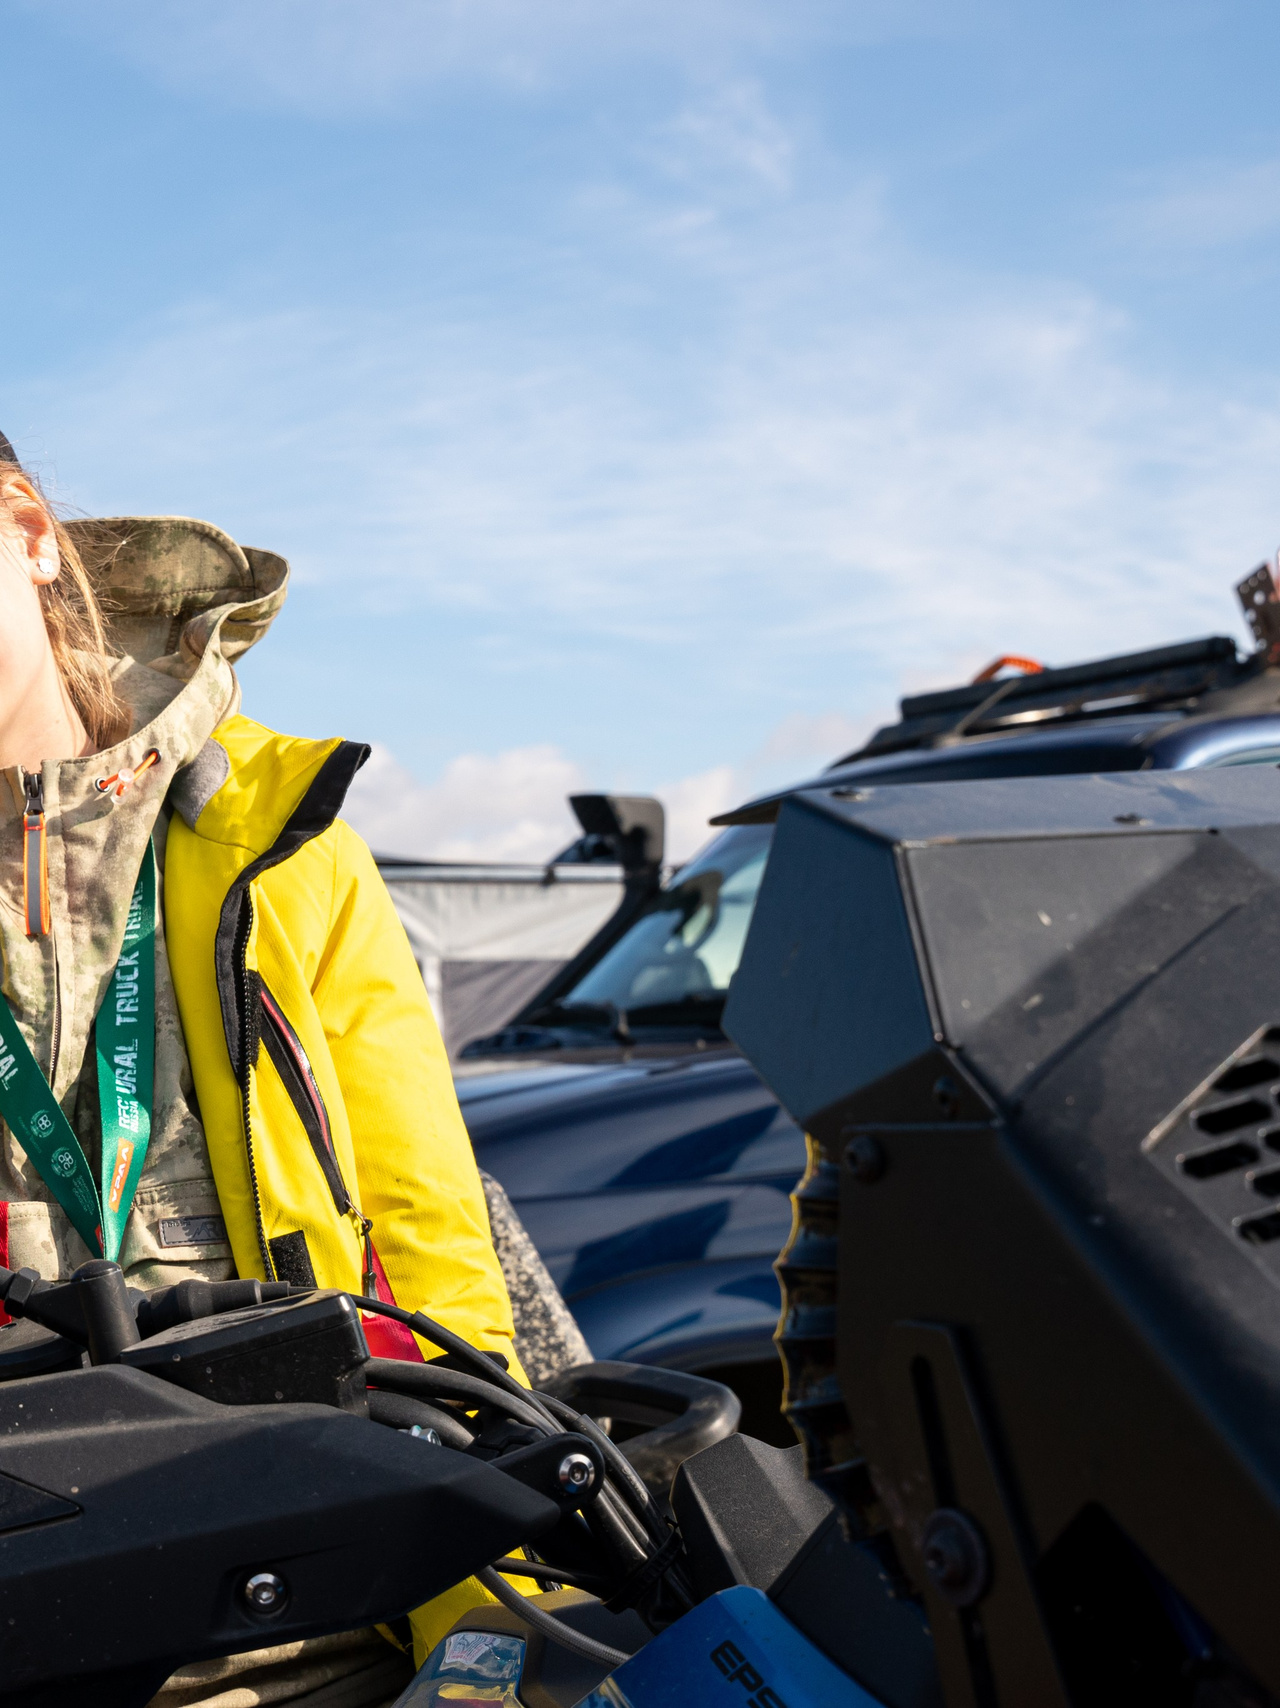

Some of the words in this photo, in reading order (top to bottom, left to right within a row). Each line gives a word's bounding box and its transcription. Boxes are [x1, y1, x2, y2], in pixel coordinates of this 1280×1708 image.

[115, 950, 140, 1027] TRUCK
[113, 1038, 138, 1096] URAL
[128, 1100, 140, 1133] RUSSIA
[709, 1639, 790, 1708] EPS
